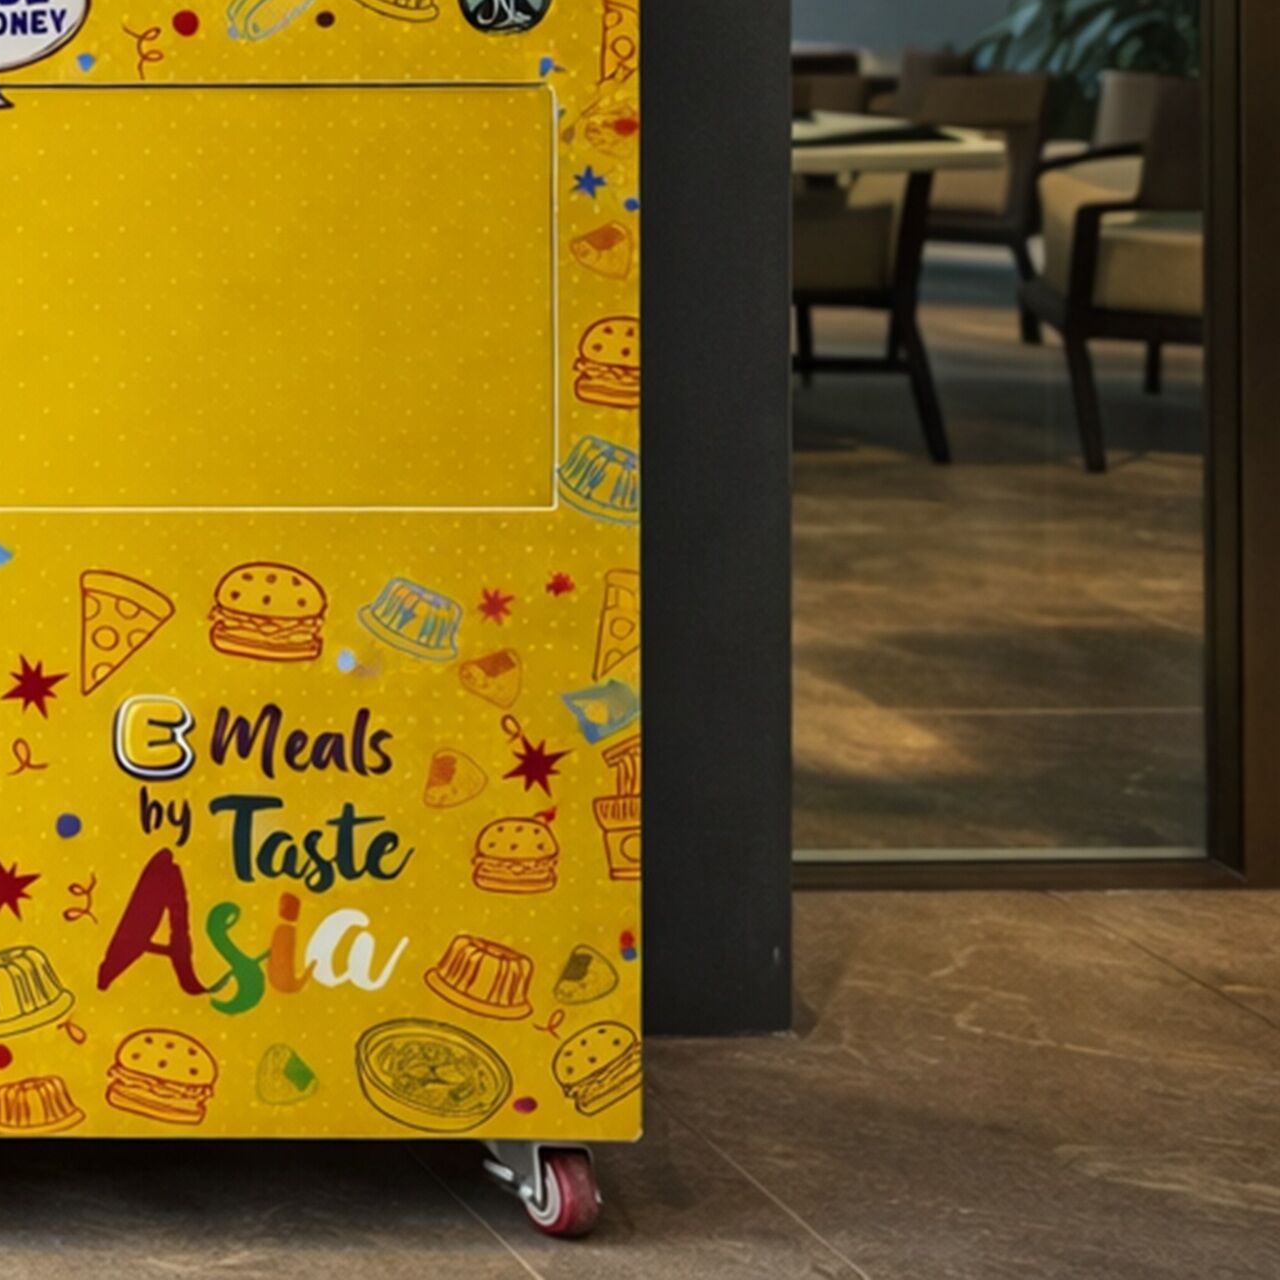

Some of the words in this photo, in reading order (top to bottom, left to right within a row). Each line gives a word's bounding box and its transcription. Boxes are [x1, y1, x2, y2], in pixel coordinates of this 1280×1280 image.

[113, 694, 196, 782] E
[210, 703, 393, 779] Meals
[139, 786, 191, 847] by
[209, 794, 414, 894] Taste
[97, 847, 410, 1014] Asia
